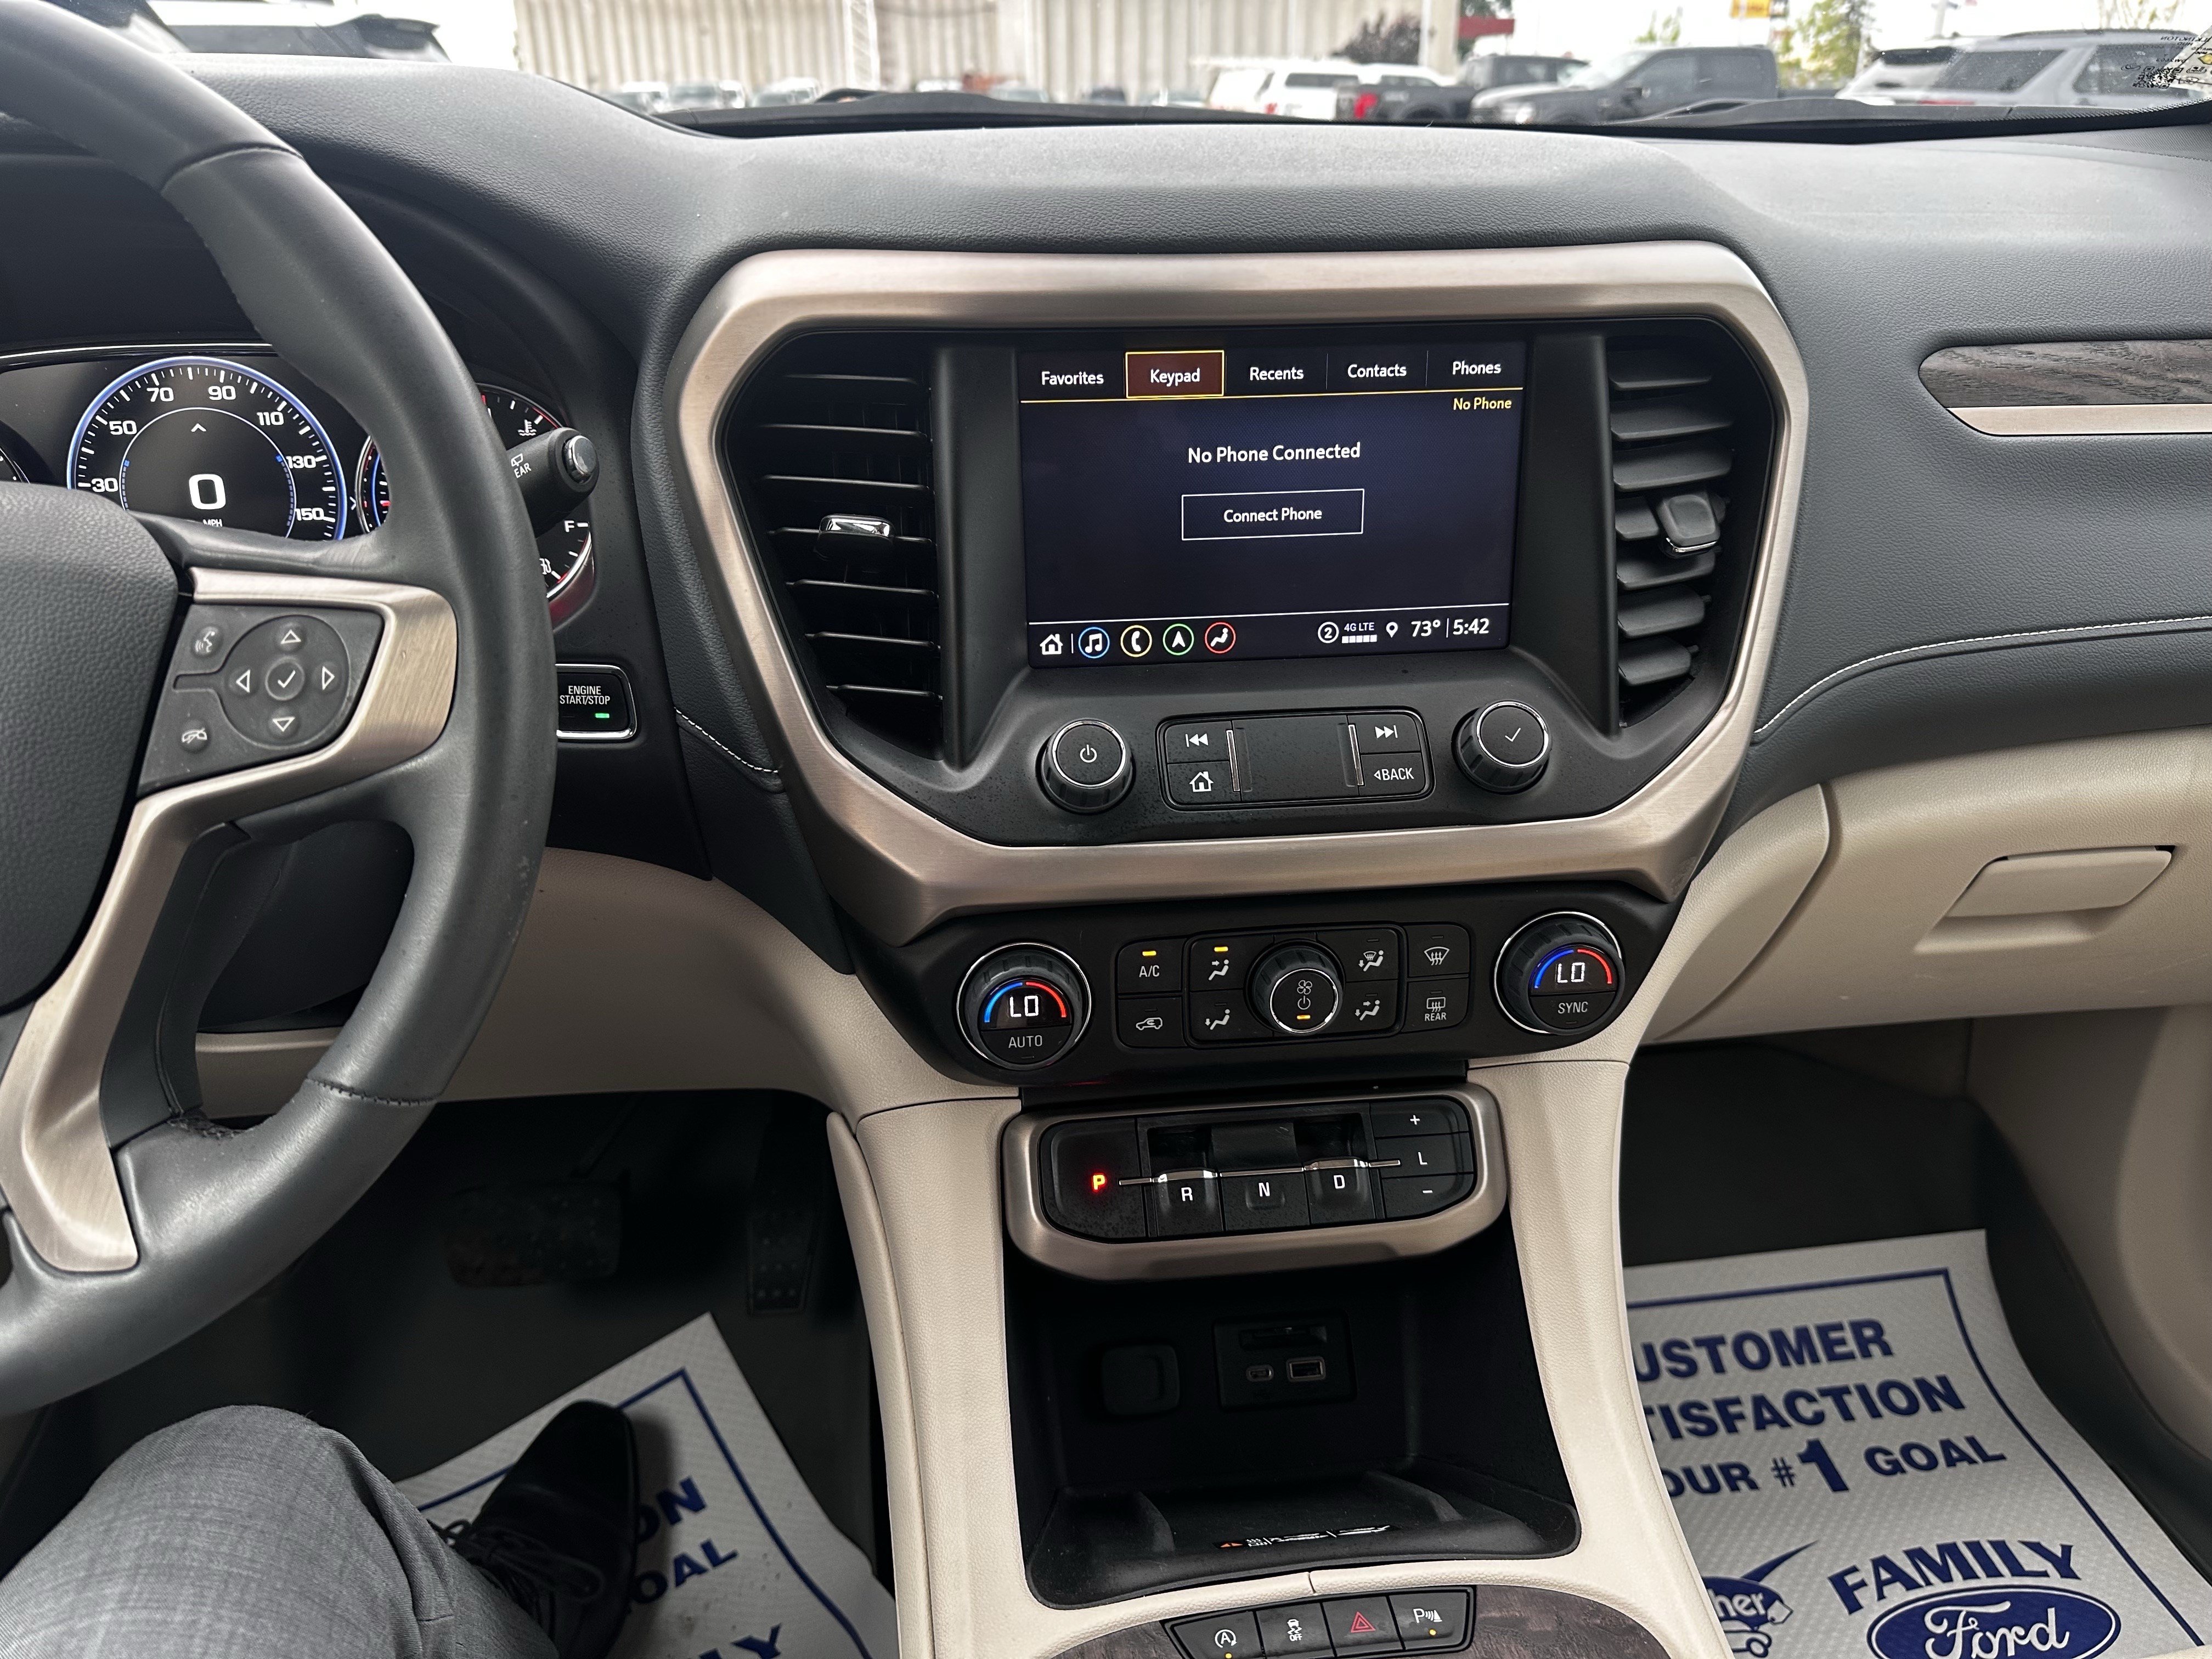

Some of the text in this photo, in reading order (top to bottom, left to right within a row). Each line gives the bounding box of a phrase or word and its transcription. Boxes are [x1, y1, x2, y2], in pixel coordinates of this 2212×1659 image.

[1250, 366, 1304, 381] Recents
[1347, 363, 1407, 378] Contacts
[1452, 360, 1502, 375] Phones
[1041, 371, 1104, 385] Favorites
[1150, 367, 1201, 387] Keypad
[146, 387, 174, 402] 70
[208, 385, 236, 400] 90
[1453, 396, 1512, 410] No Phone
[256, 411, 284, 426] 110
[109, 420, 137, 435] 50
[1188, 441, 1361, 464] No Phone Connected
[286, 455, 317, 470] 130
[514, 462, 532, 478] EAR
[91, 478, 119, 493] 30
[188, 473, 226, 510] 0
[295, 507, 325, 522] 150
[1223, 506, 1323, 523] Connect Phone
[203, 519, 222, 527] MPH
[564, 520, 575, 533] F
[1344, 622, 1375, 632] 4G LTE
[1453, 618, 1489, 635] 5:42
[568, 685, 602, 696] ENGINE
[560, 695, 611, 705] START/STOP
[1381, 768, 1414, 781] BACK
[1139, 964, 1160, 978] A/C
[1558, 1001, 1588, 1014] SYNC
[1424, 1010, 1447, 1022] REAR
[1008, 1035, 1042, 1048] AUTO
[1418, 1152, 1428, 1165] L
[1092, 1173, 1106, 1192] P
[1258, 1182, 1271, 1197] N
[1333, 1175, 1345, 1189] D
[1181, 1187, 1193, 1201] R
[1863, 1435, 2006, 1477] GOAL
[1828, 1539, 2081, 1615] FAMILY
[1289, 1633, 1302, 1641] OFF
[1923, 1600, 2070, 1659] Ford
